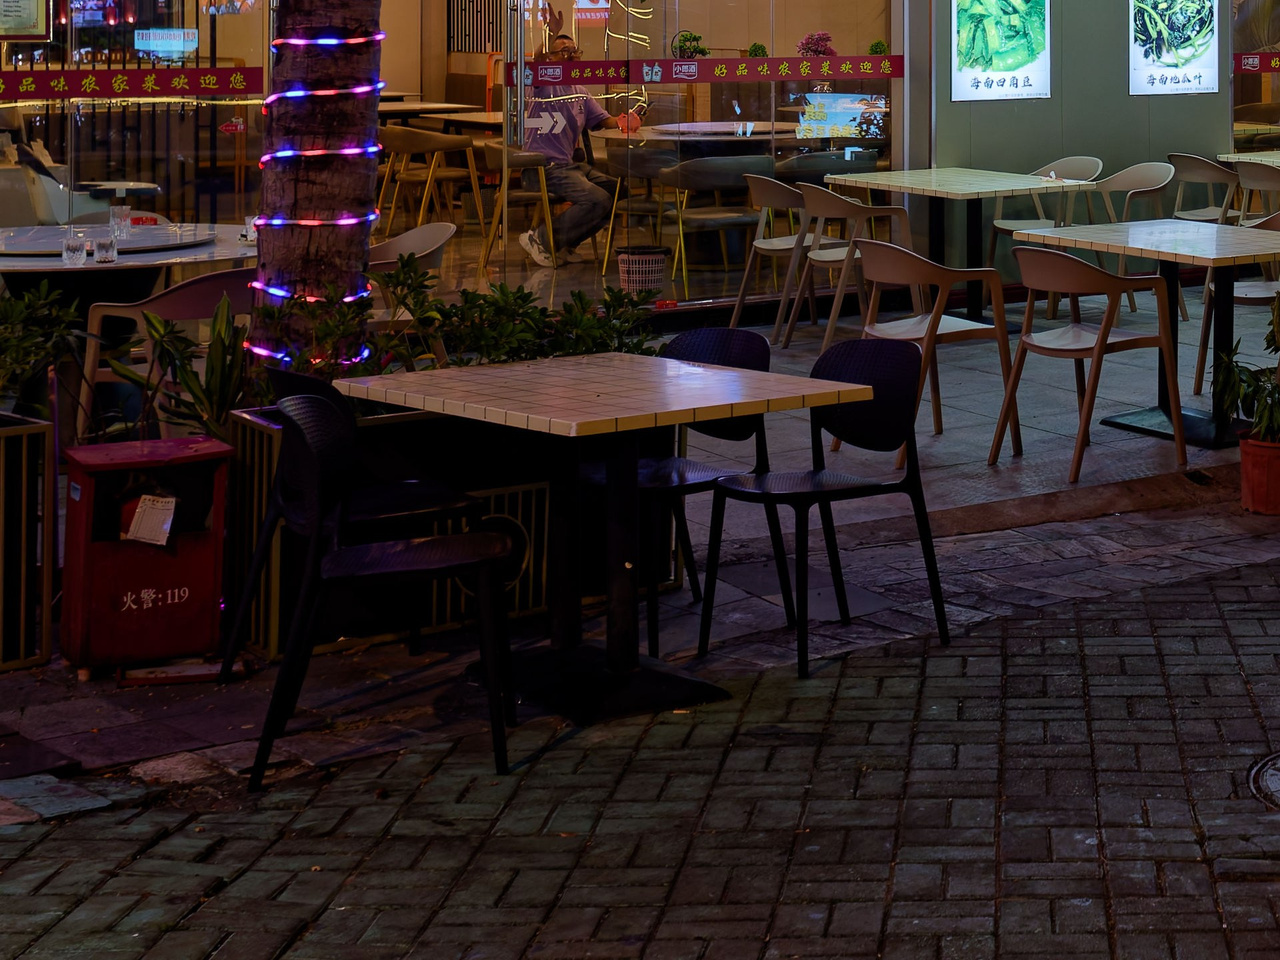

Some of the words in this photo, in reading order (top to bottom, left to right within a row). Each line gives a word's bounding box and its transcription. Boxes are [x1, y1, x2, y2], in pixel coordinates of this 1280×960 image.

[714, 59, 893, 77] 好品味农家菜欢迎您
